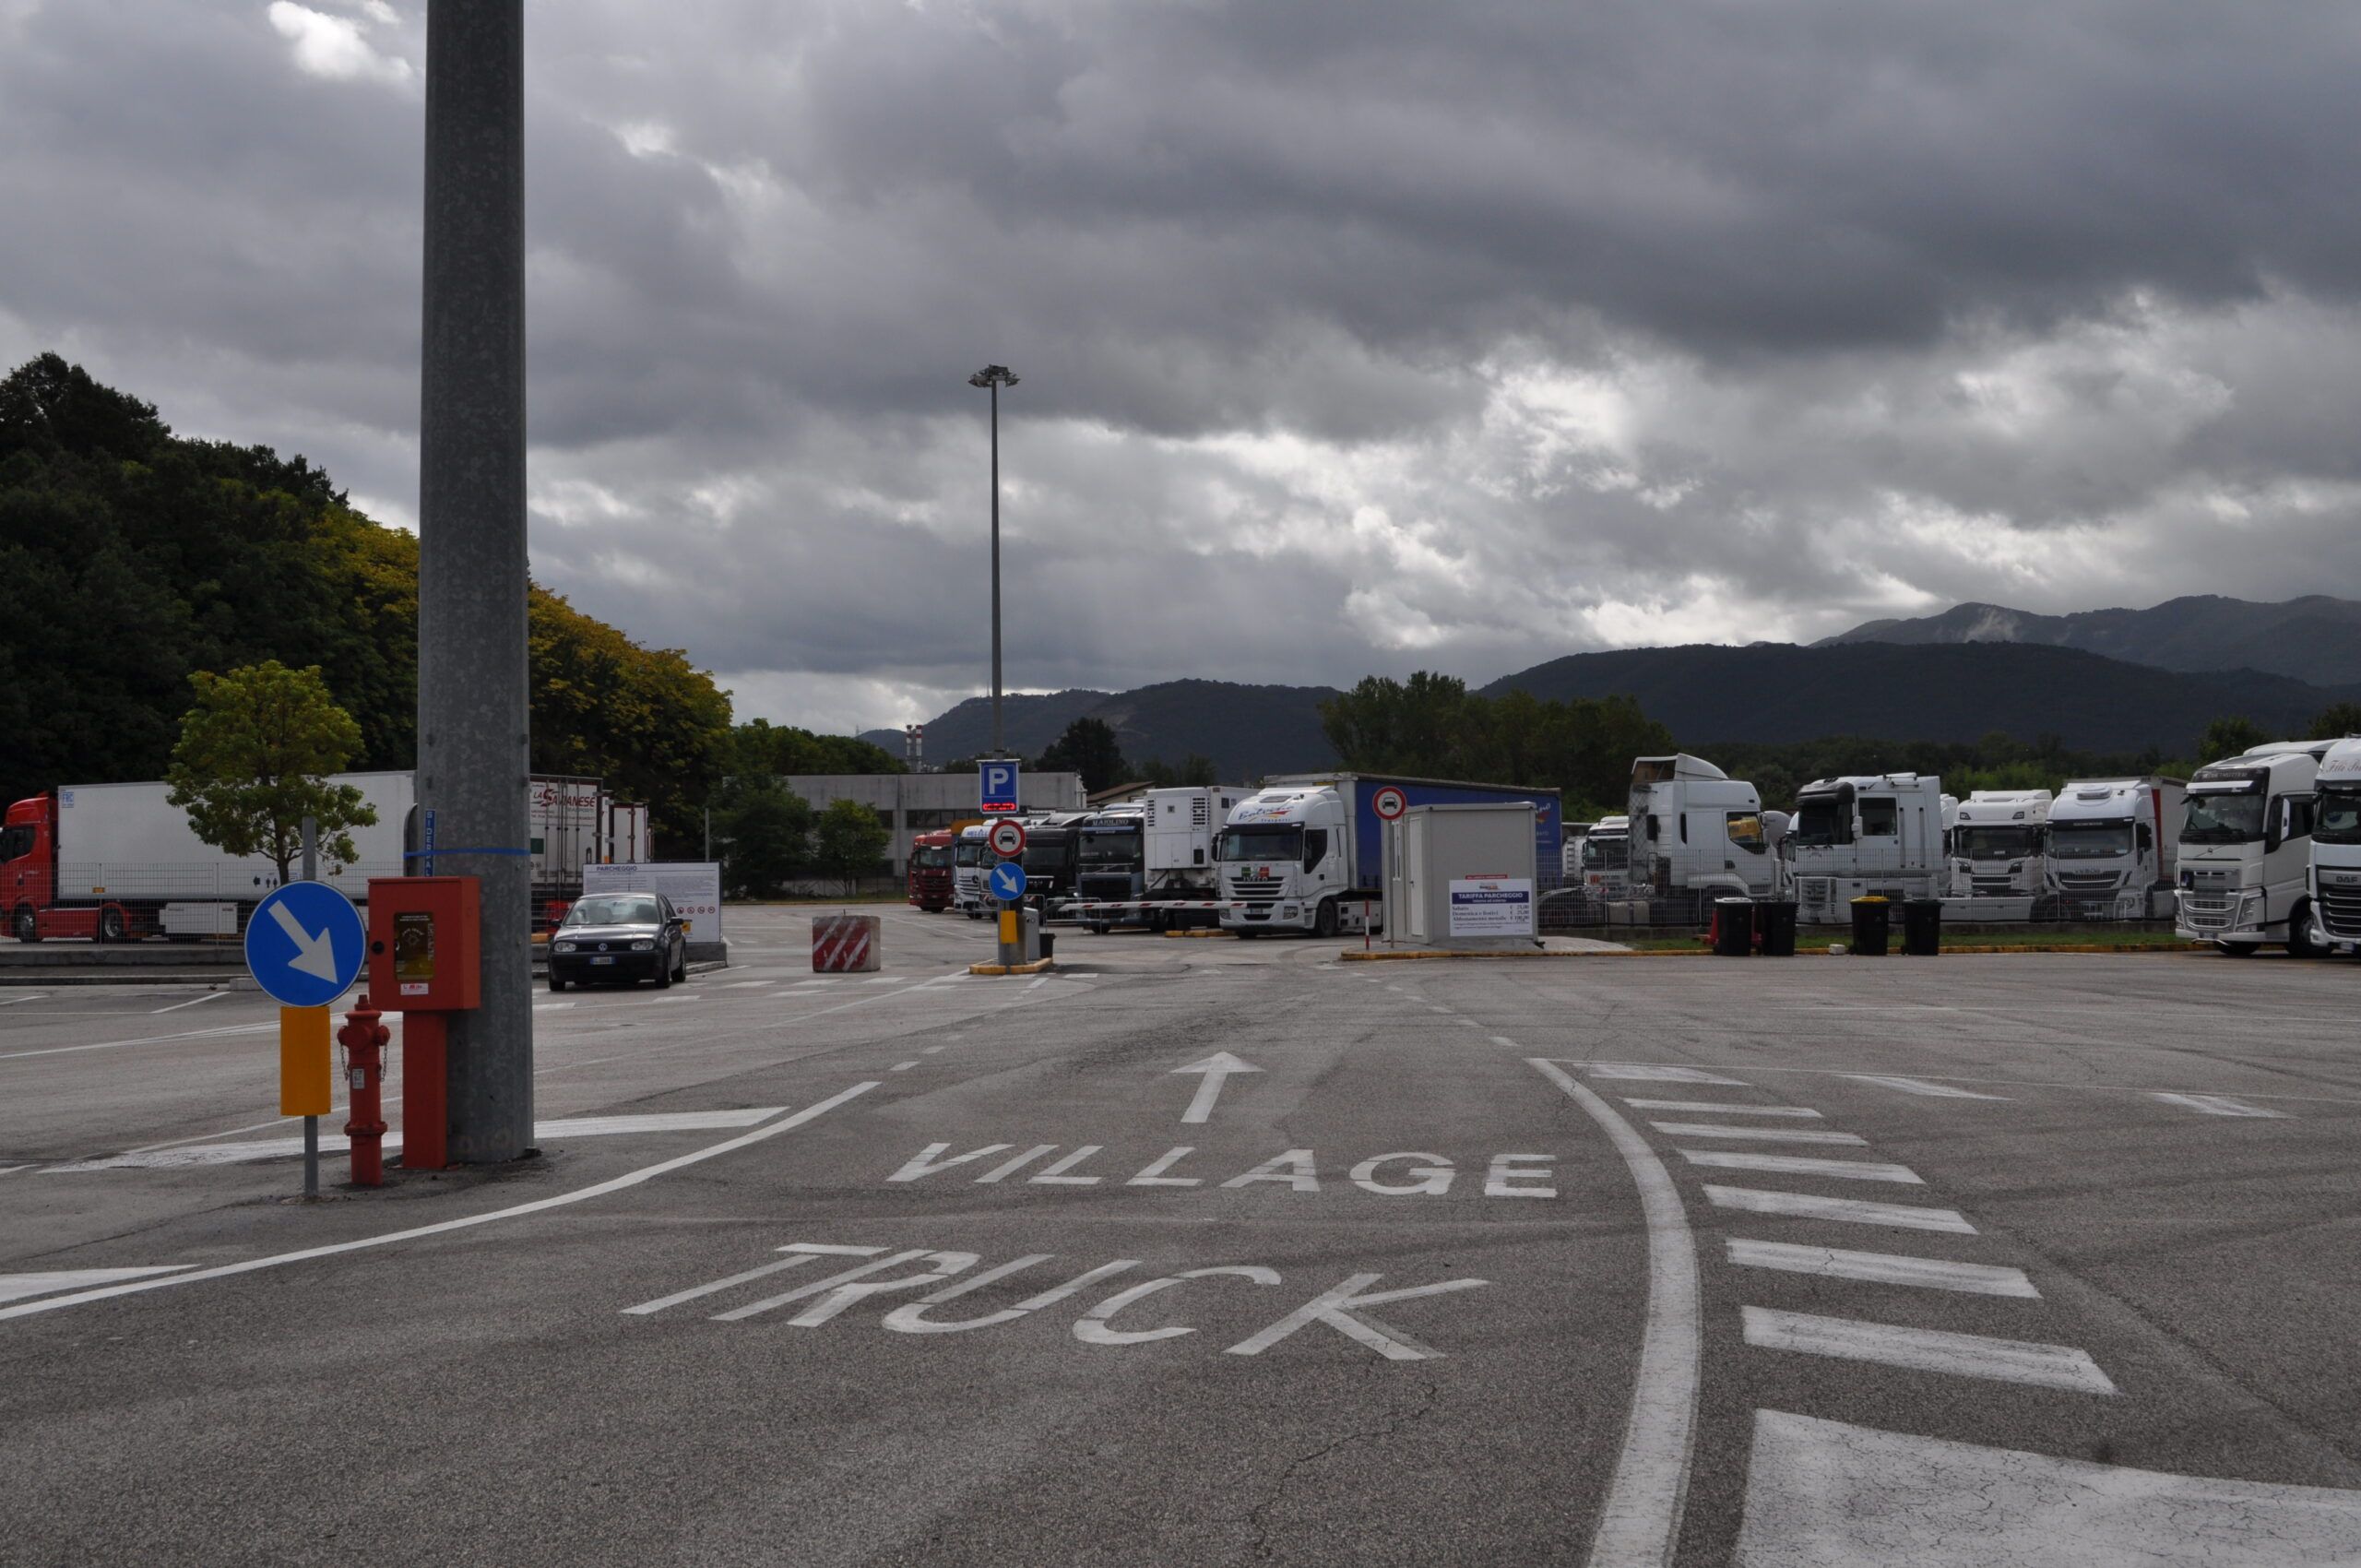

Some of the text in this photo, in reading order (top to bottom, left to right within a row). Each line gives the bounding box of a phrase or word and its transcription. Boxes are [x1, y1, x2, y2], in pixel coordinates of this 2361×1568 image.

[989, 768, 1009, 795] P
[887, 1142, 1560, 1199] VILLAGE
[620, 1242, 1489, 1361] TRUCK
